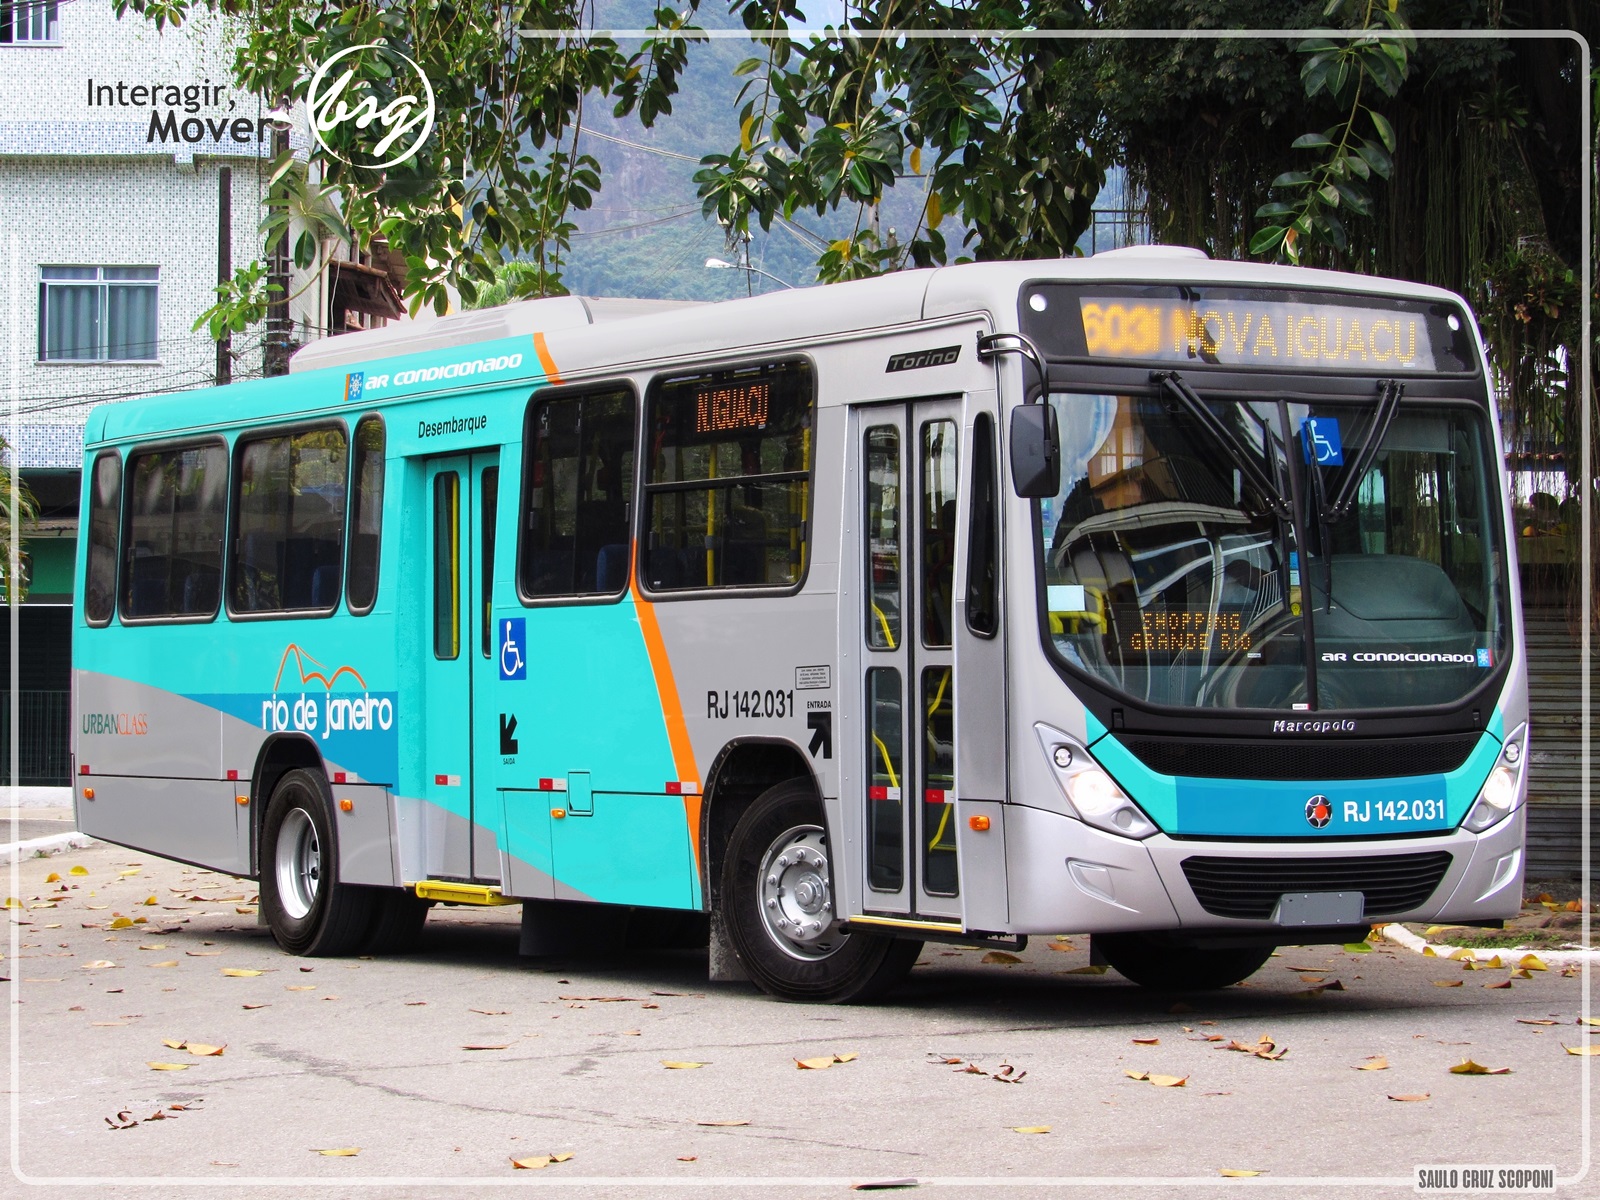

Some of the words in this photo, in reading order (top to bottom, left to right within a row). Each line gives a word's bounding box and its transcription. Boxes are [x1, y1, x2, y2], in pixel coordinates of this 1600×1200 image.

[1174, 308, 1278, 357] NOVA
[890, 350, 957, 370] Torino
[418, 414, 487, 439] Desembarque
[1142, 613, 1240, 630] SHOPPING
[1131, 633, 1209, 650] GRANDE
[1221, 633, 1251, 650] RIO
[707, 690, 729, 719] RJ
[732, 689, 794, 719] 142.031
[807, 700, 832, 709] ENTRADA
[1273, 719, 1356, 733] Marcopolo
[1343, 801, 1371, 823] RJ
[1374, 799, 1445, 822] 142.031
